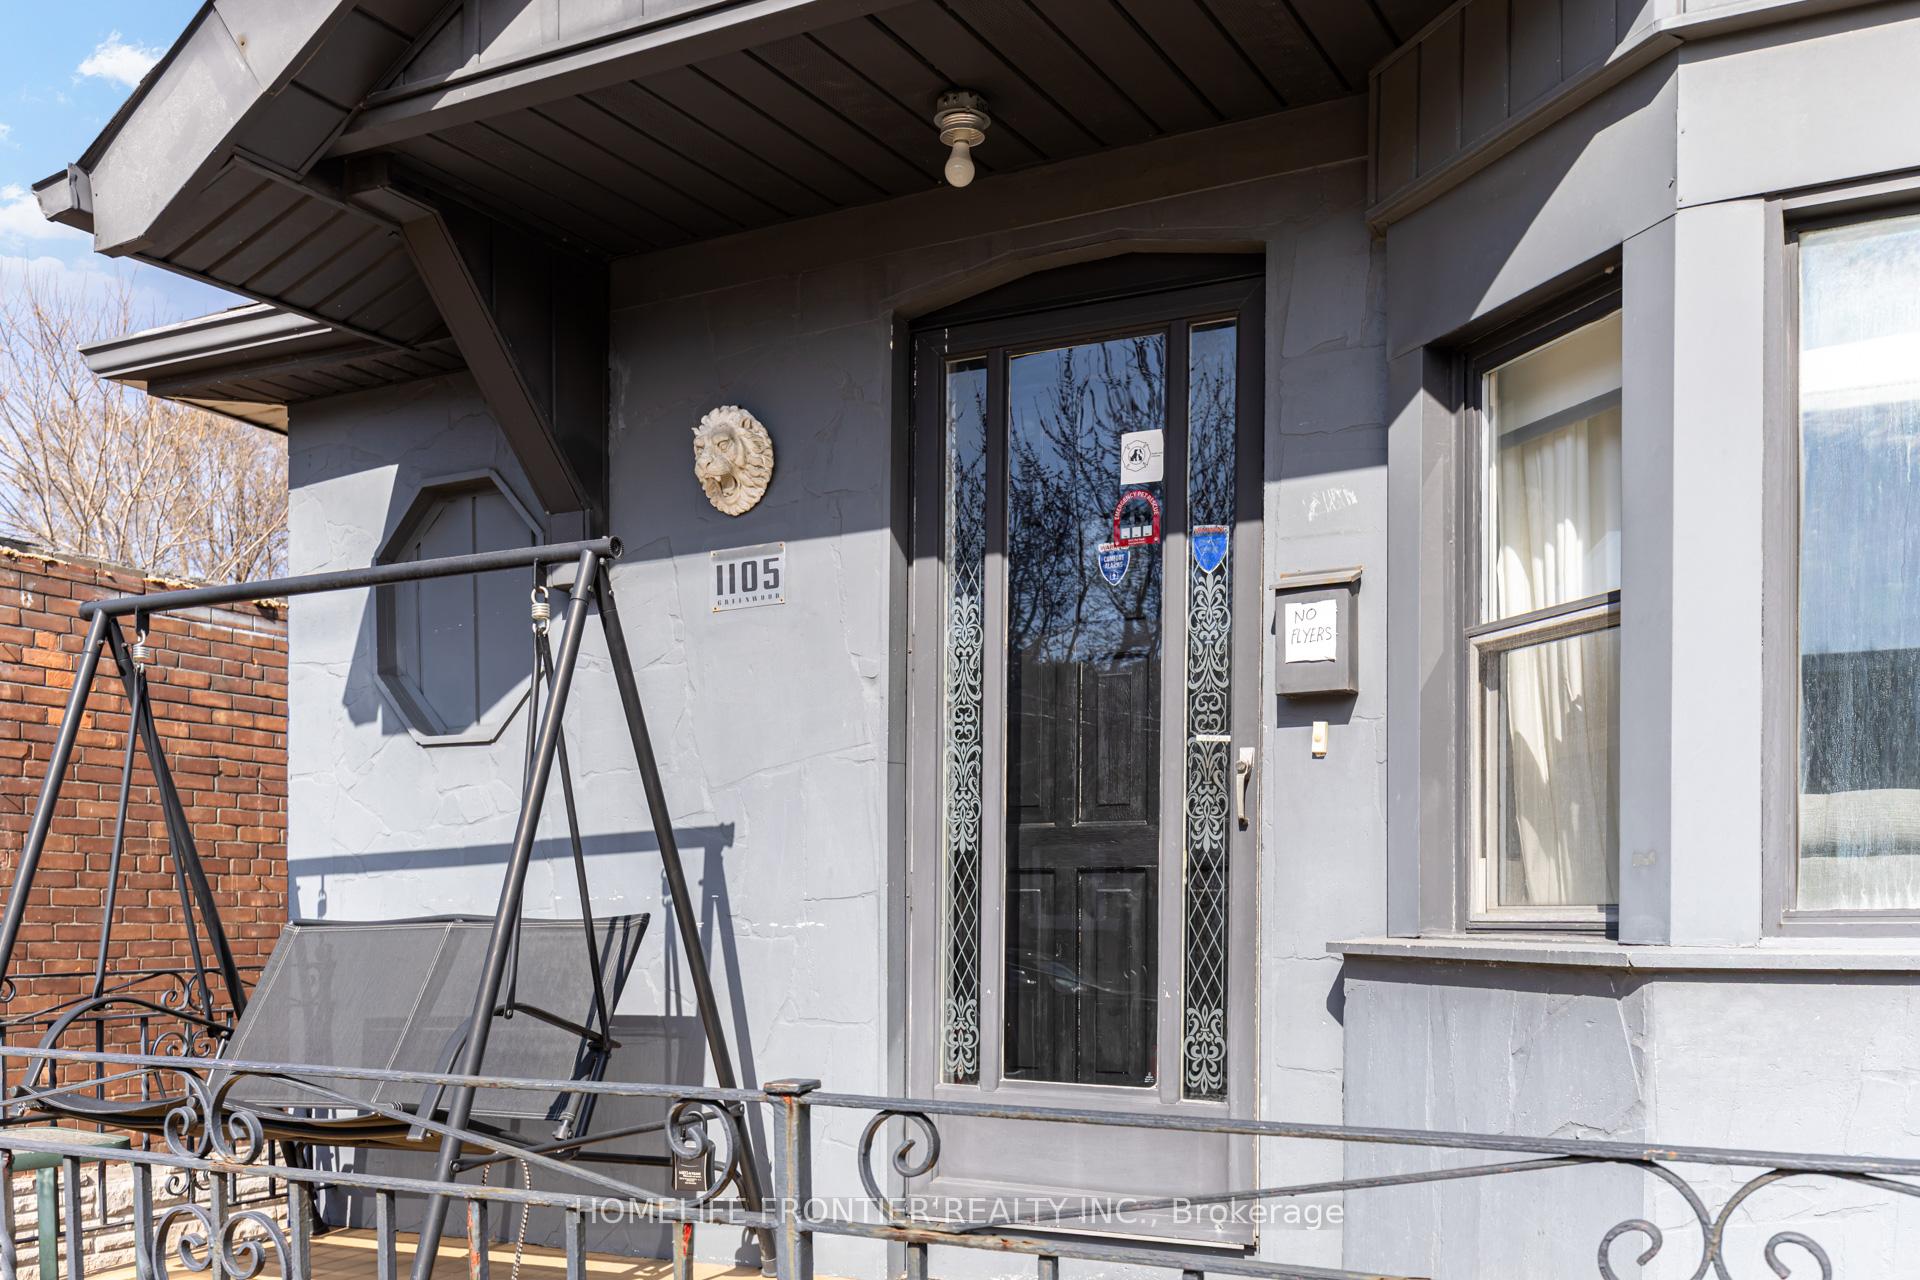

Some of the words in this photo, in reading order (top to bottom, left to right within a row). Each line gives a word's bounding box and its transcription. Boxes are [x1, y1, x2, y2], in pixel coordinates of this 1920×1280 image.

[1114, 491, 1137, 520] EMERGENCY
[1137, 490, 1149, 499] PET
[716, 557, 780, 596] 1105
[1294, 608, 1317, 624] NO
[1291, 626, 1332, 645] FLYERS
